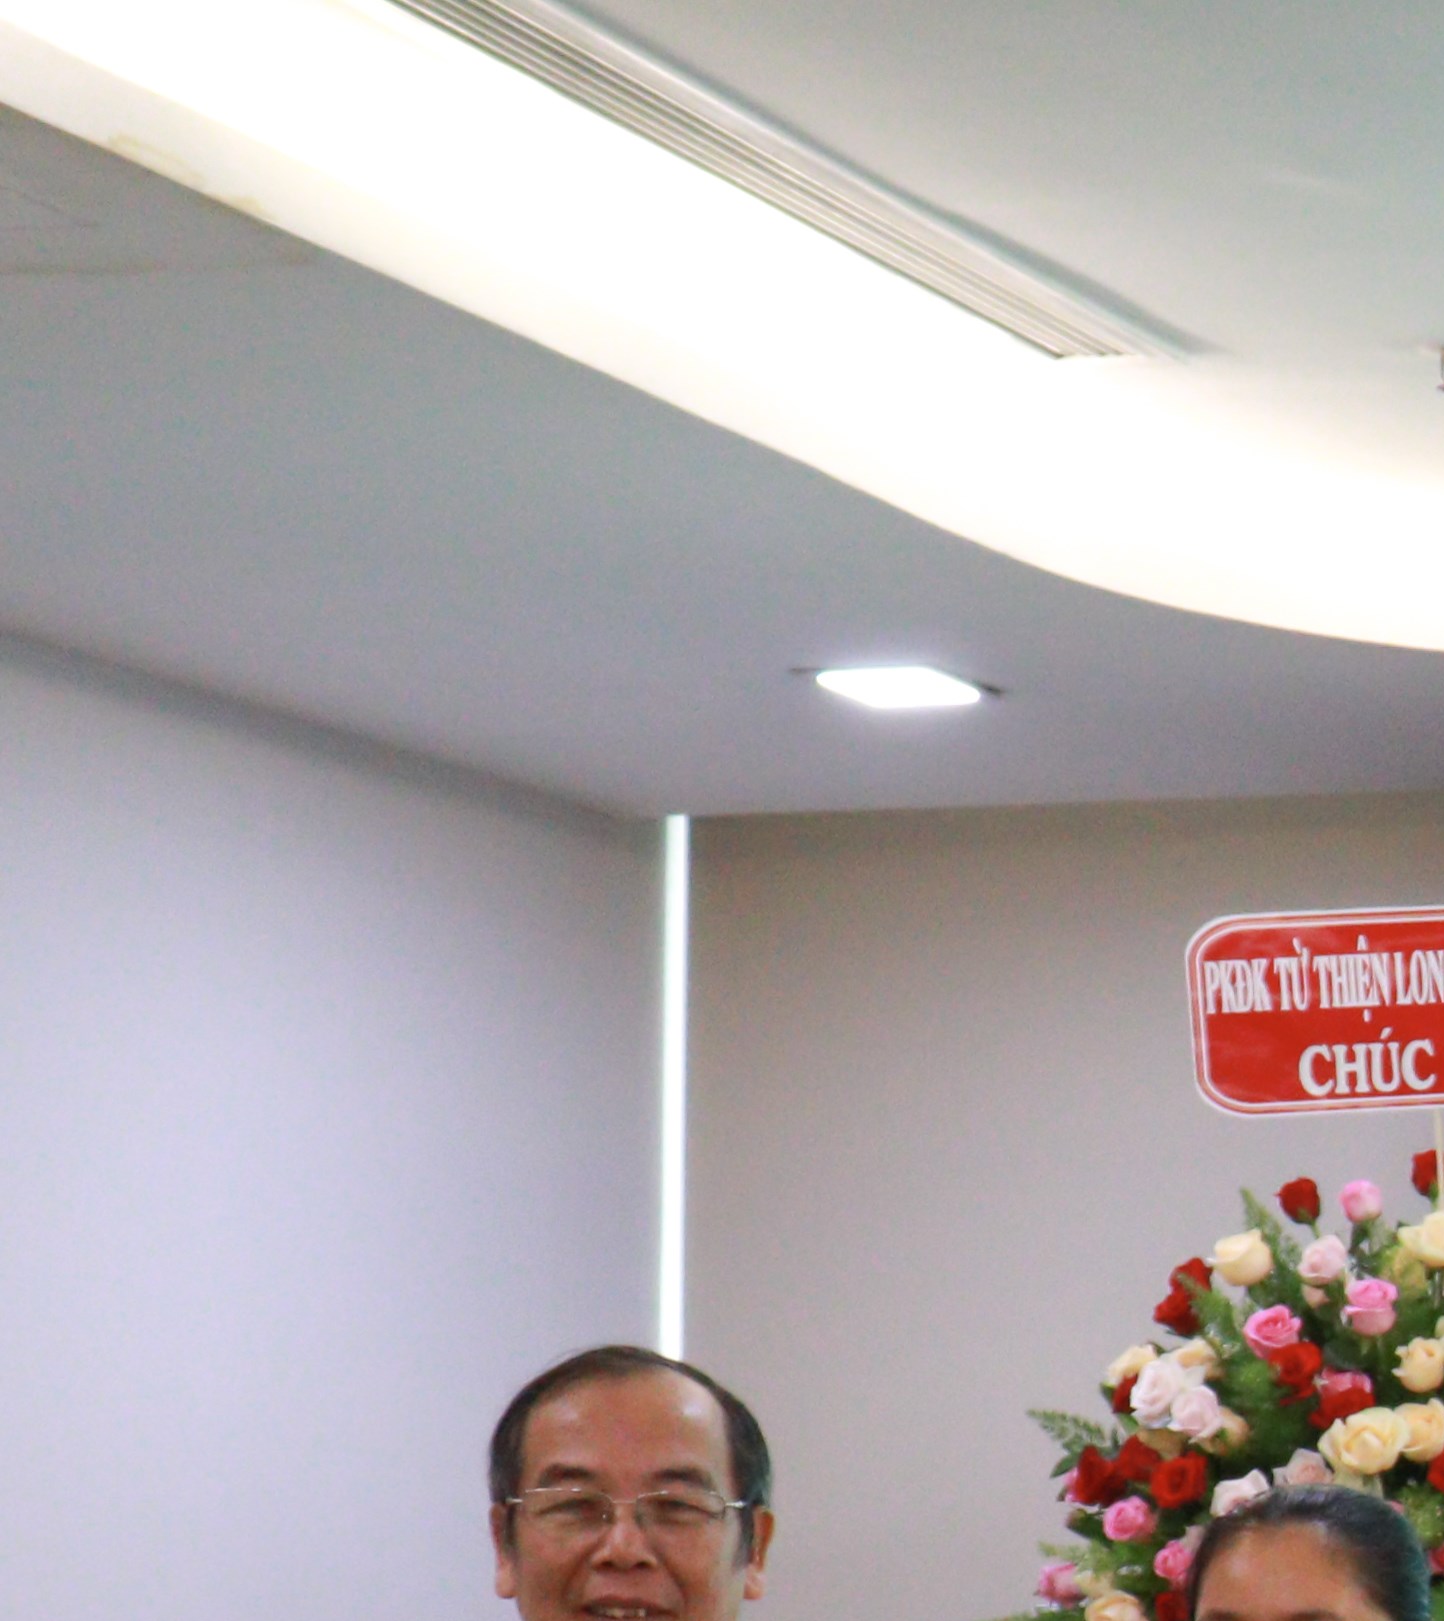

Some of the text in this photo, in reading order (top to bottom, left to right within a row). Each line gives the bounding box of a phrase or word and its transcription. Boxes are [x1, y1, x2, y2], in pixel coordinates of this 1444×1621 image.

[1204, 958, 1273, 1015] PKĐK
[1273, 937, 1312, 1012] TỪ
[1312, 934, 1393, 1023] THIỆN
[1299, 1027, 1436, 1096] CHÚC
